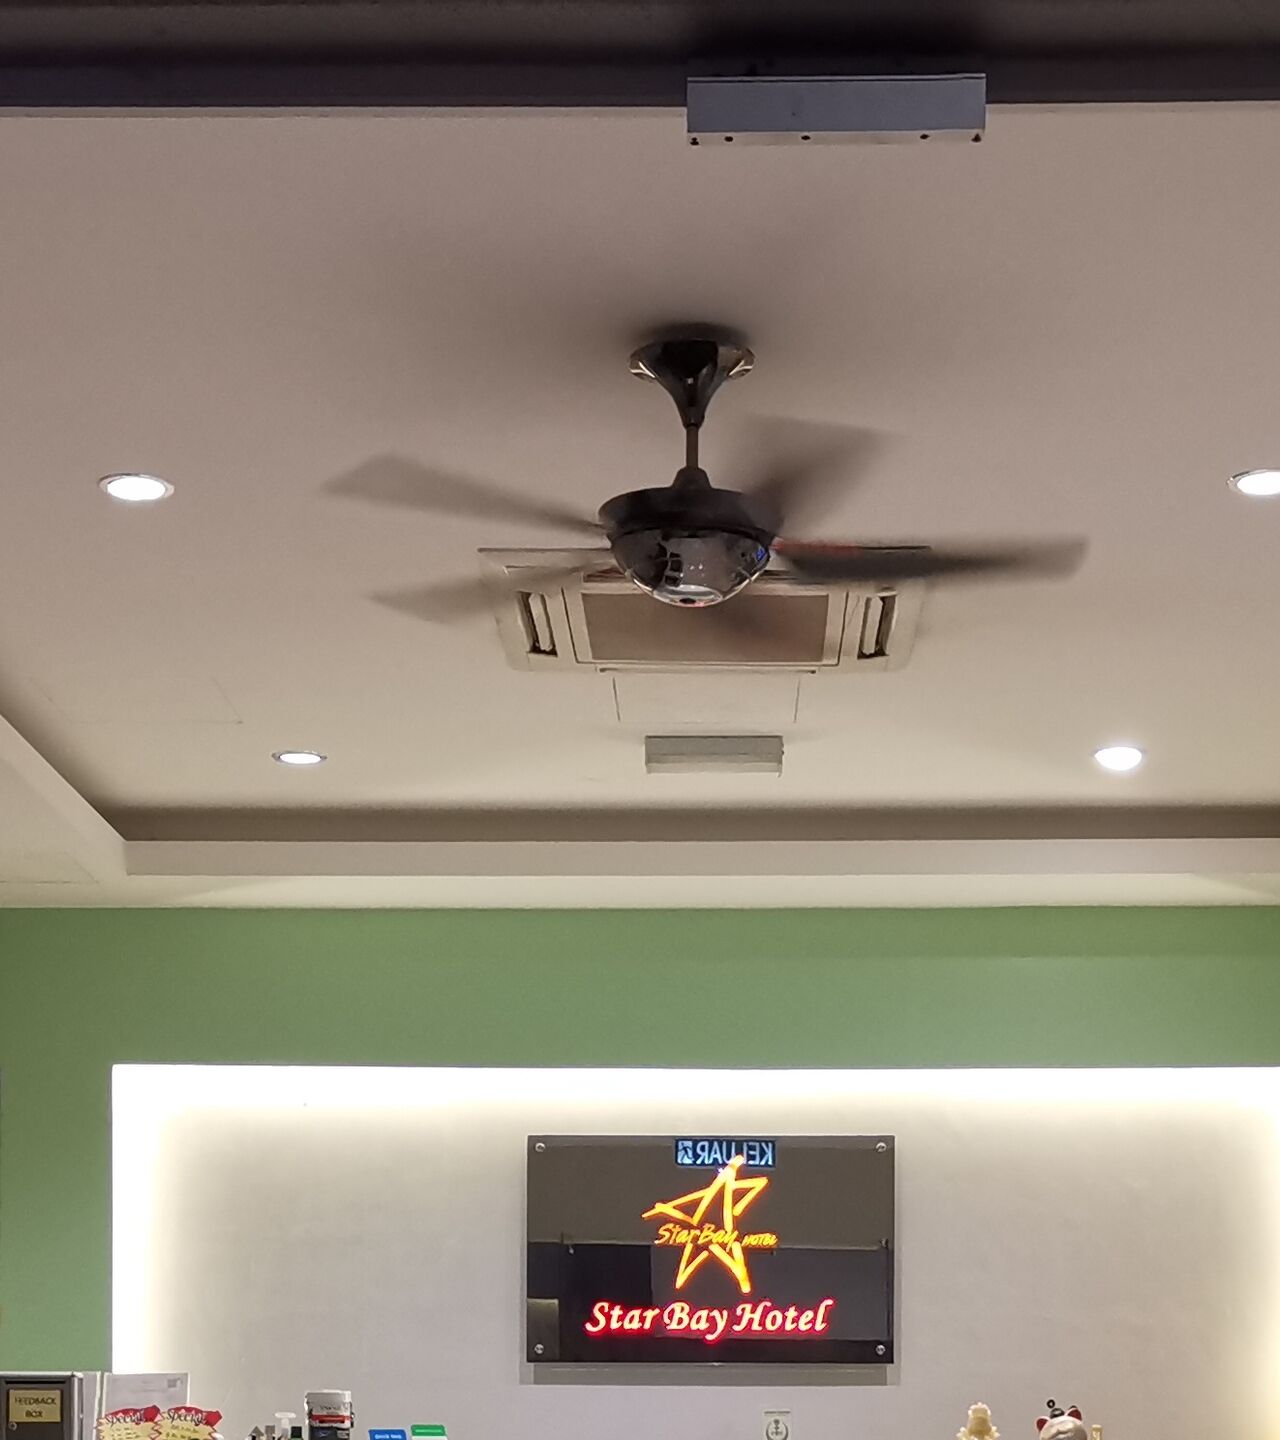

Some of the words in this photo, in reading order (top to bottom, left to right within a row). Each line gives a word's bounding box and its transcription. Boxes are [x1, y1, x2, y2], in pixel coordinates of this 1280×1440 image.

[653, 1222, 701, 1245] Star
[696, 1222, 739, 1253] Bay
[584, 1301, 660, 1333] Star
[662, 1301, 729, 1342] Bay
[731, 1298, 835, 1332] Hotel
[14, 1396, 57, 1406] FEEDBACK
[25, 1409, 44, 1418] BOX
